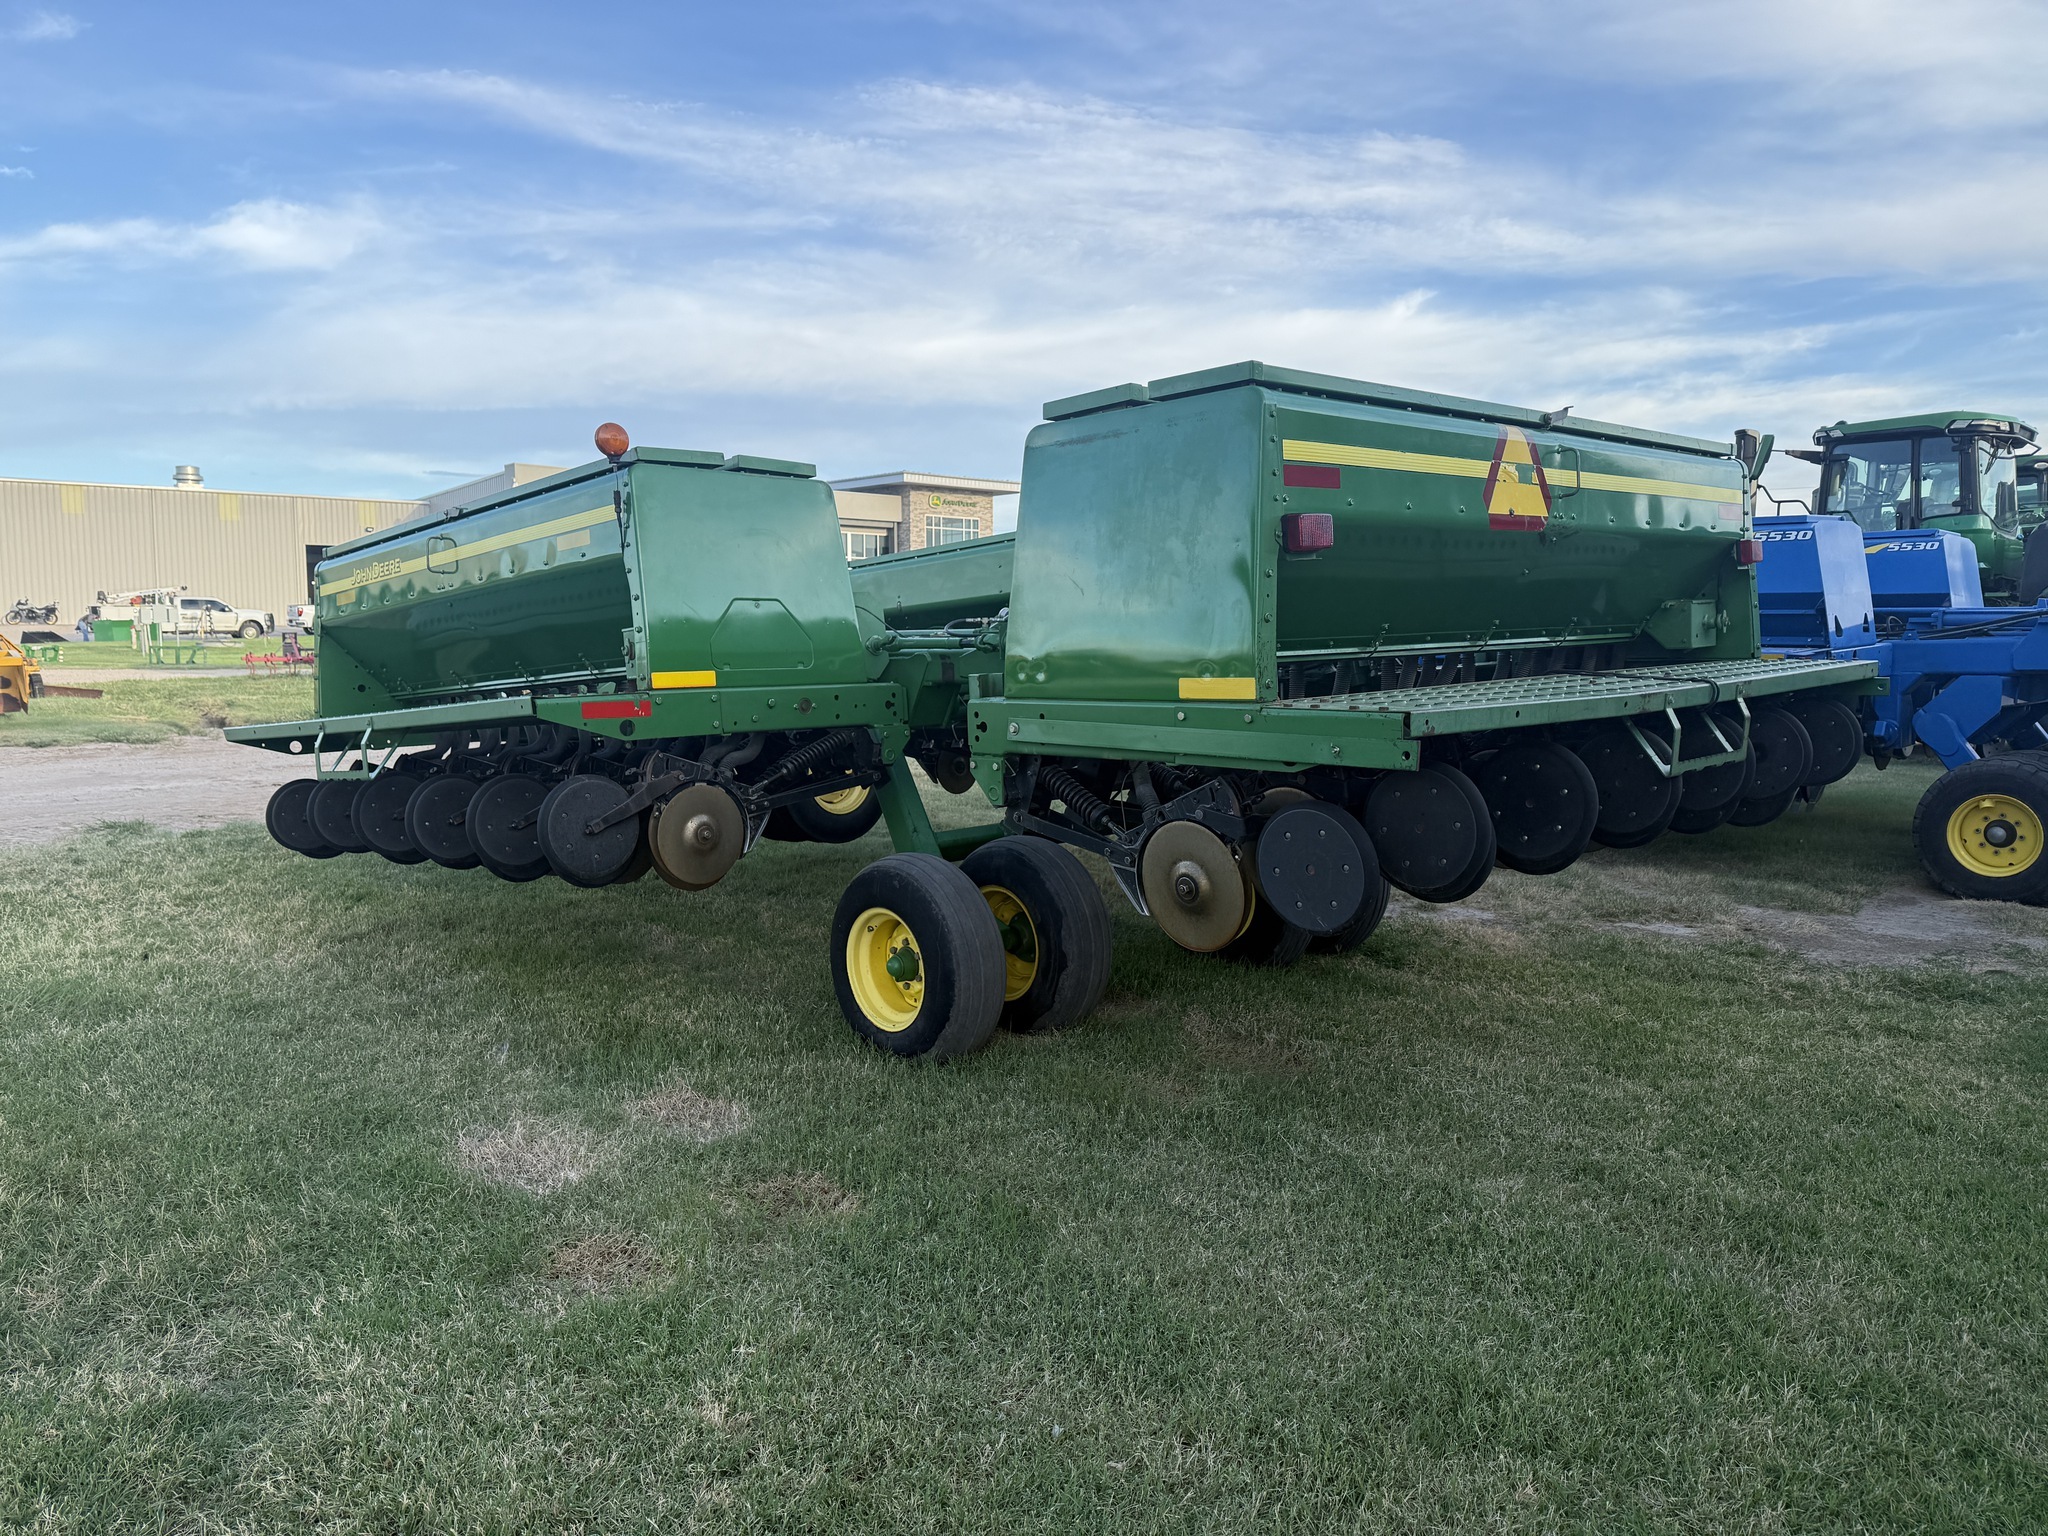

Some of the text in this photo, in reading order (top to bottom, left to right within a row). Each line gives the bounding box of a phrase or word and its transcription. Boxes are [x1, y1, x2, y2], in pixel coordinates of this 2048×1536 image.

[1754, 530, 1813, 542] 5530
[1887, 541, 1940, 552] 5530
[351, 557, 401, 586] JOHN DEERE
